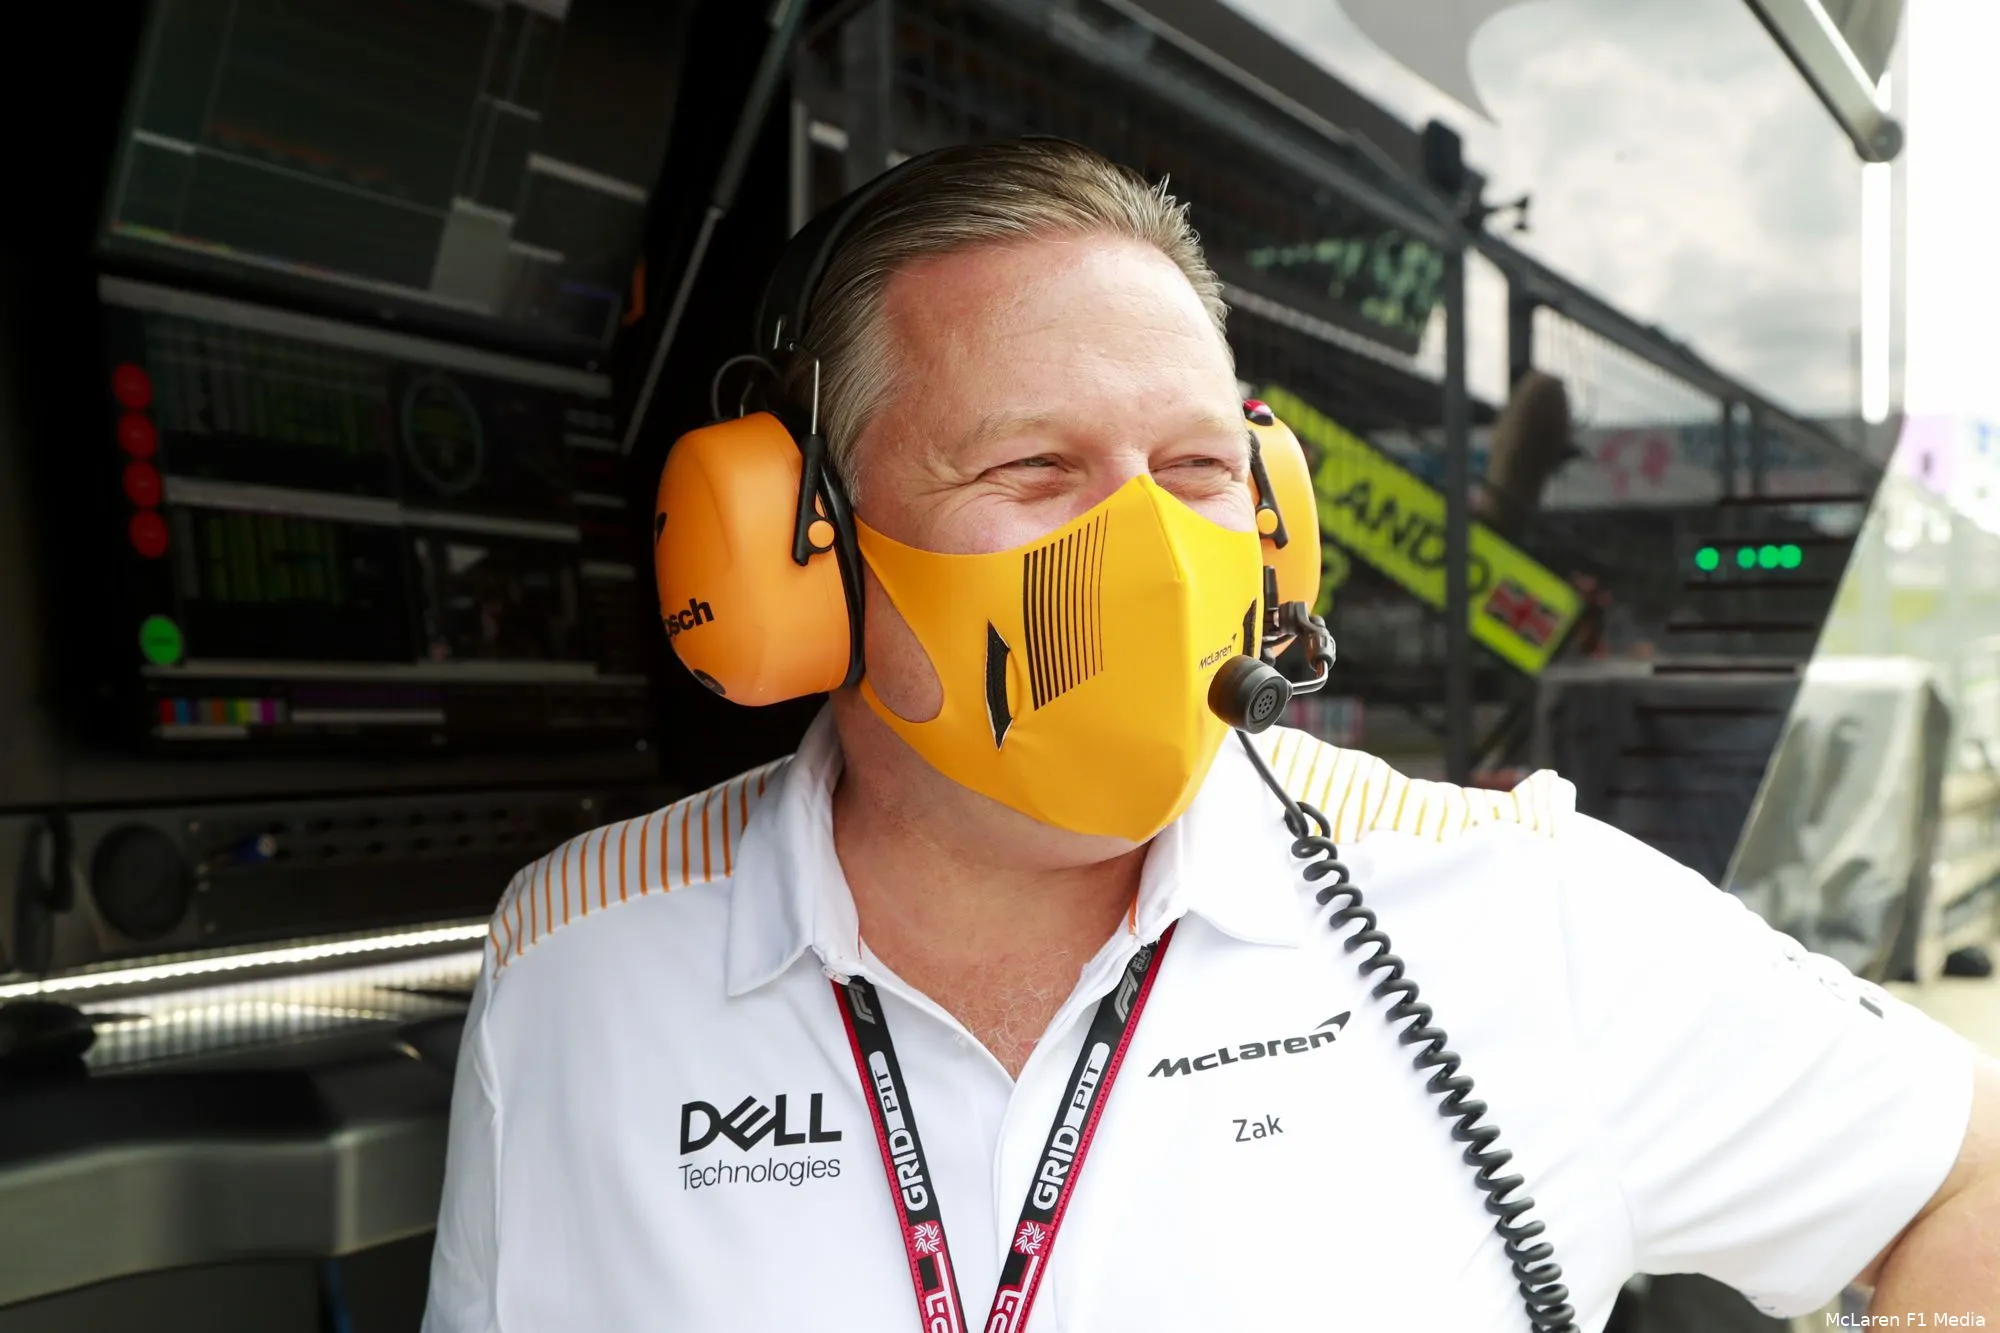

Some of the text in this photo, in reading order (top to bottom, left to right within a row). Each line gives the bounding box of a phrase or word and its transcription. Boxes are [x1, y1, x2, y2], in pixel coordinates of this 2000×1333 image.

[665, 598, 715, 638] sch
[1148, 1028, 1338, 1078] McLaren
[680, 1093, 842, 1155] DELL
[874, 1069, 929, 1211] GRID PIT
[1032, 1059, 1099, 1211] GRID PIT
[1232, 1114, 1284, 1143] Zak
[679, 1155, 841, 1191] Technologies
